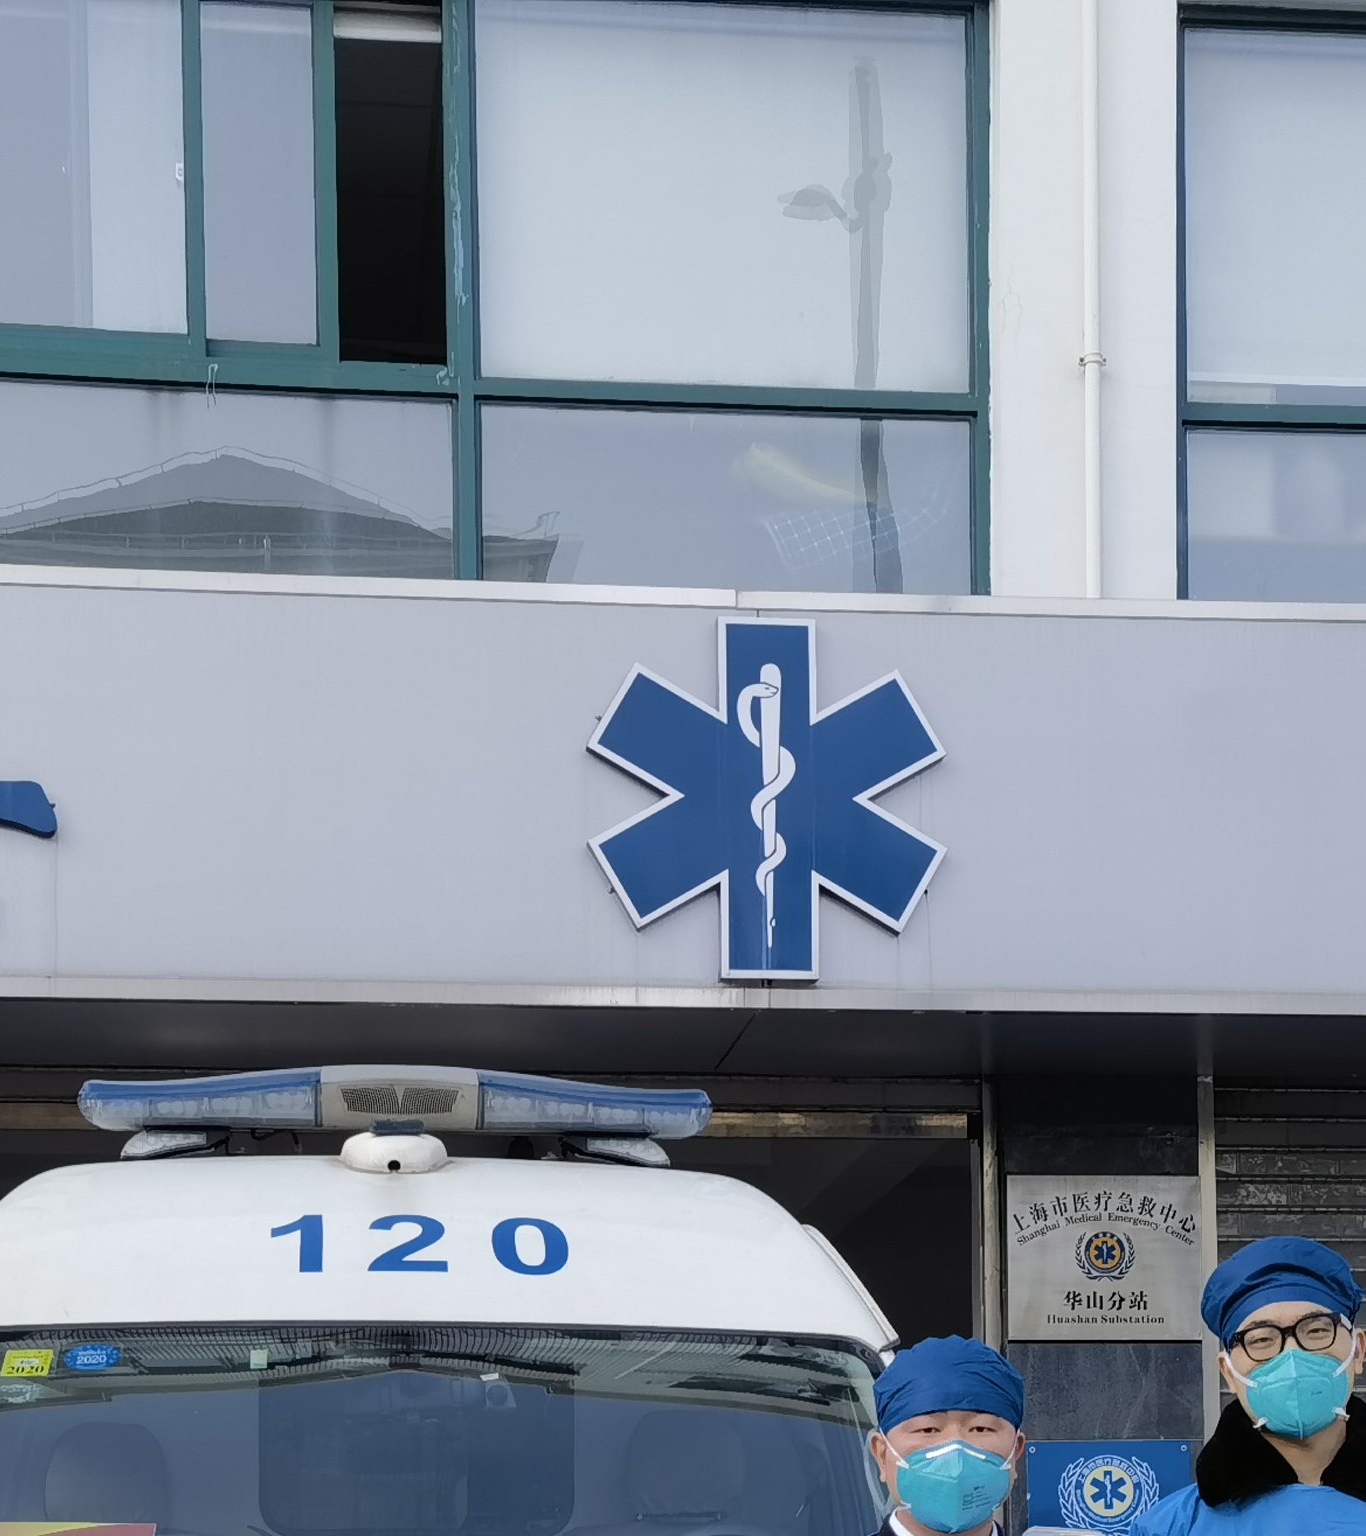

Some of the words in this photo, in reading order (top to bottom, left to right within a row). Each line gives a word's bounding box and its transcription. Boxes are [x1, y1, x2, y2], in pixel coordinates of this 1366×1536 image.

[1012, 1190, 1196, 1235] 上海市医疗急救中心
[1016, 1220, 1061, 1247] Shanghai
[1064, 1212, 1103, 1227] Medical
[1107, 1211, 1162, 1231] Emergency
[1164, 1224, 1196, 1248] Center
[270, 1214, 570, 1276] 120
[1063, 1290, 1149, 1313] 华山分站
[1046, 1313, 1098, 1325] Huashan
[1100, 1313, 1165, 1325] Substation
[6, 1365, 45, 1375] 2020
[75, 1354, 107, 1365] 2020
